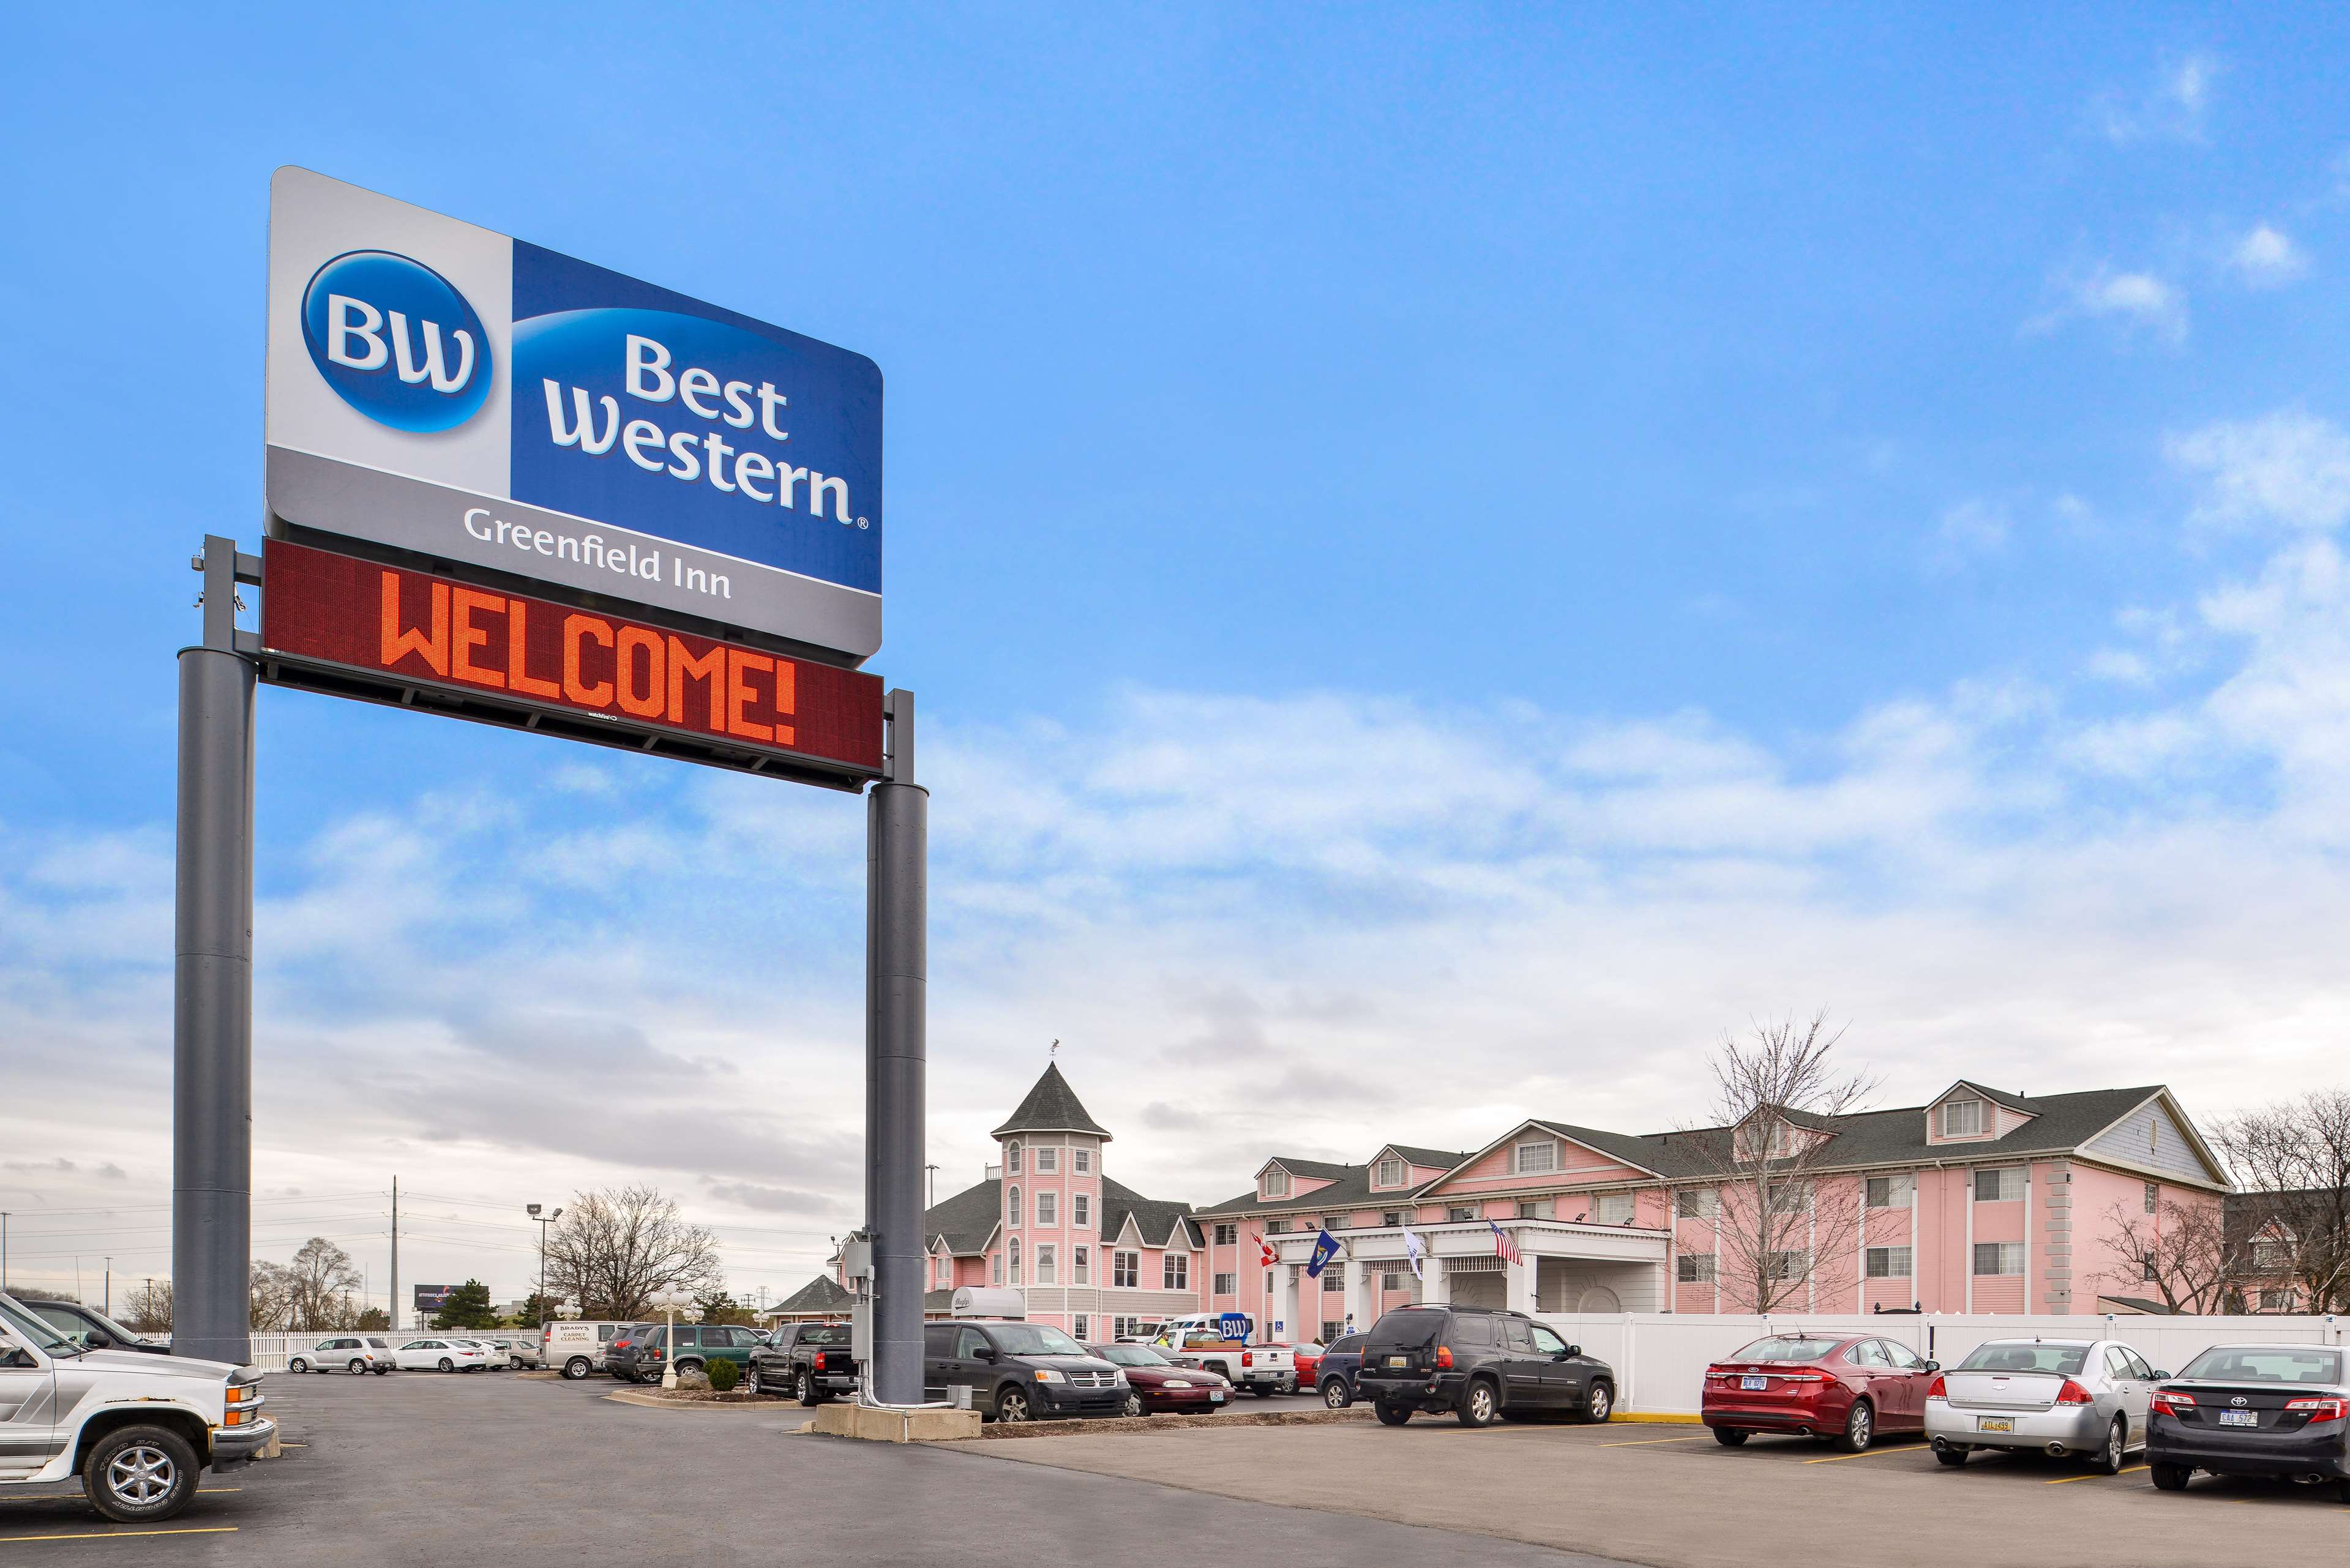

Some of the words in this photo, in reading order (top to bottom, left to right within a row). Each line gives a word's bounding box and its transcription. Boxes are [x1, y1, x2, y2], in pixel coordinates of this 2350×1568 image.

[329, 294, 475, 394] BW
[626, 334, 790, 441] Best
[464, 507, 662, 582] Greenfield
[675, 558, 732, 600] Inn
[381, 571, 796, 746] WELCOME!
[1222, 1320, 1246, 1338] BW
